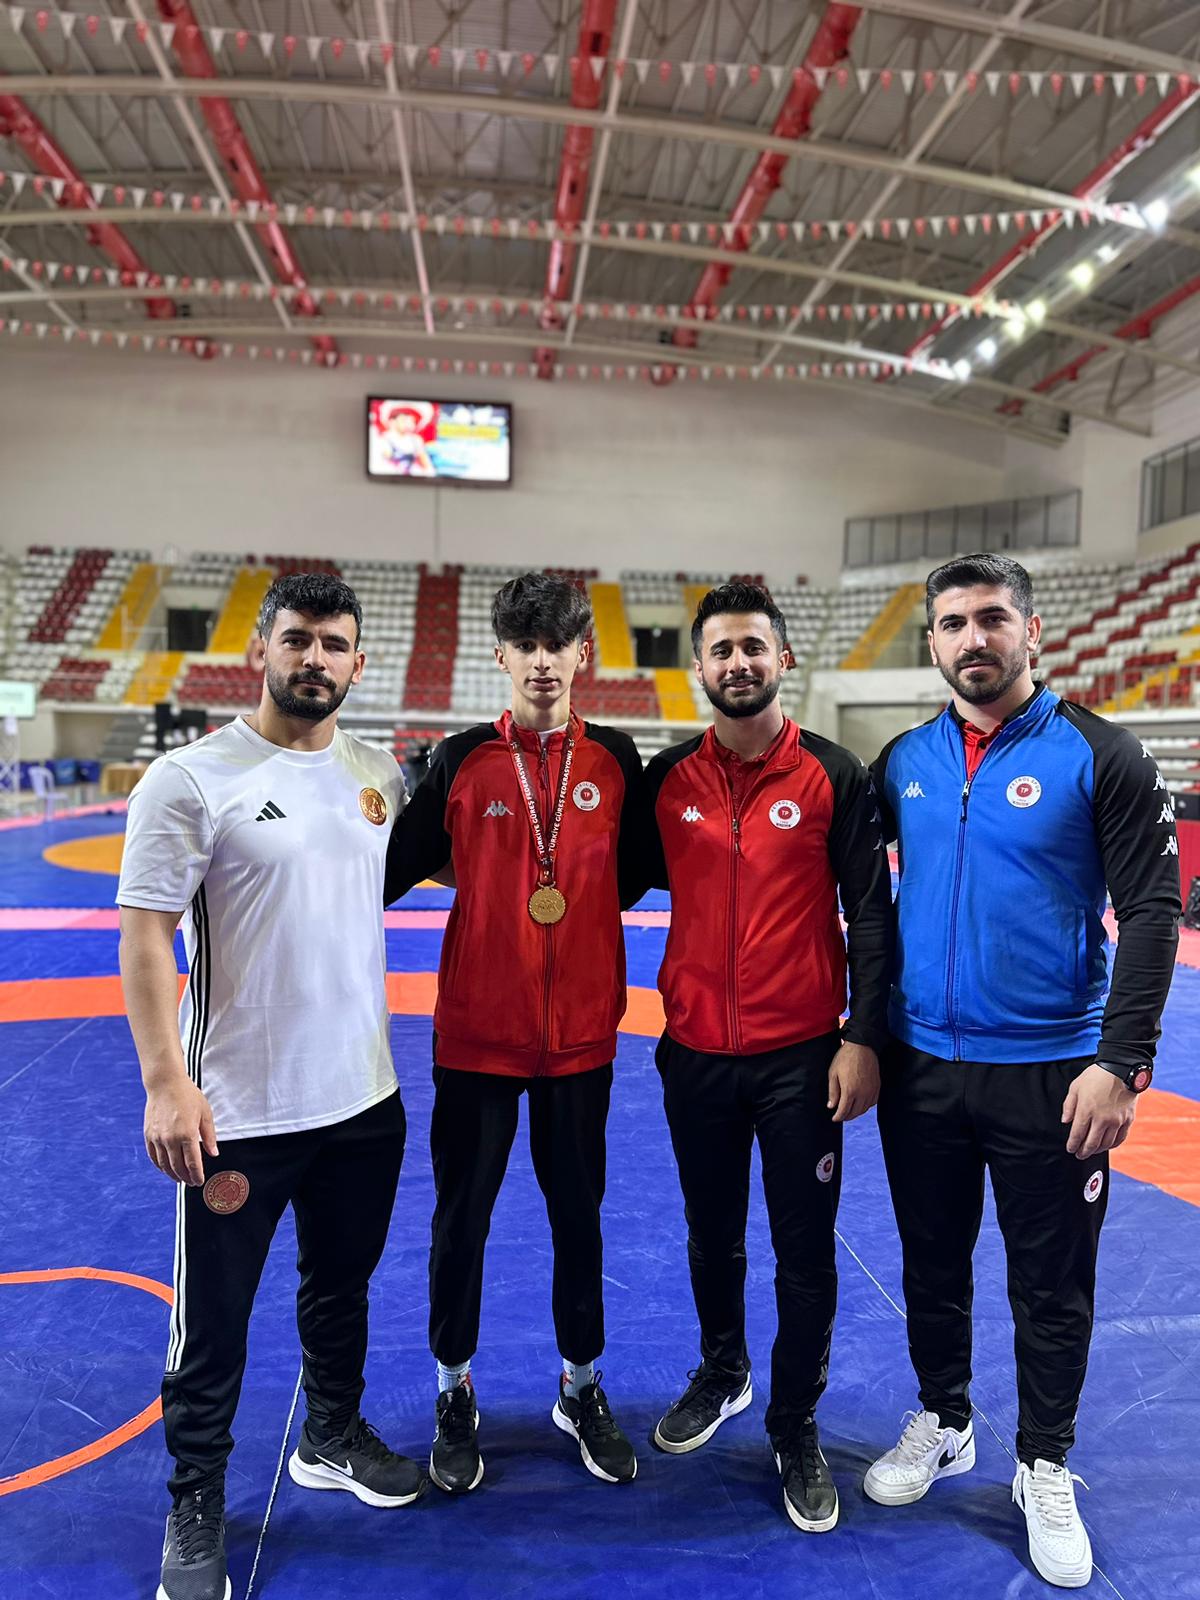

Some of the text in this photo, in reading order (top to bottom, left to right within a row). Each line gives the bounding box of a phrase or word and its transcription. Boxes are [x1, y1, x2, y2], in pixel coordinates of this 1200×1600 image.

[513, 753, 545, 855] TÜRKİYE GÜREŞ FEDERASYONU
[548, 750, 573, 852] TÜRKİYE GÜREŞ FEDERASYONU
